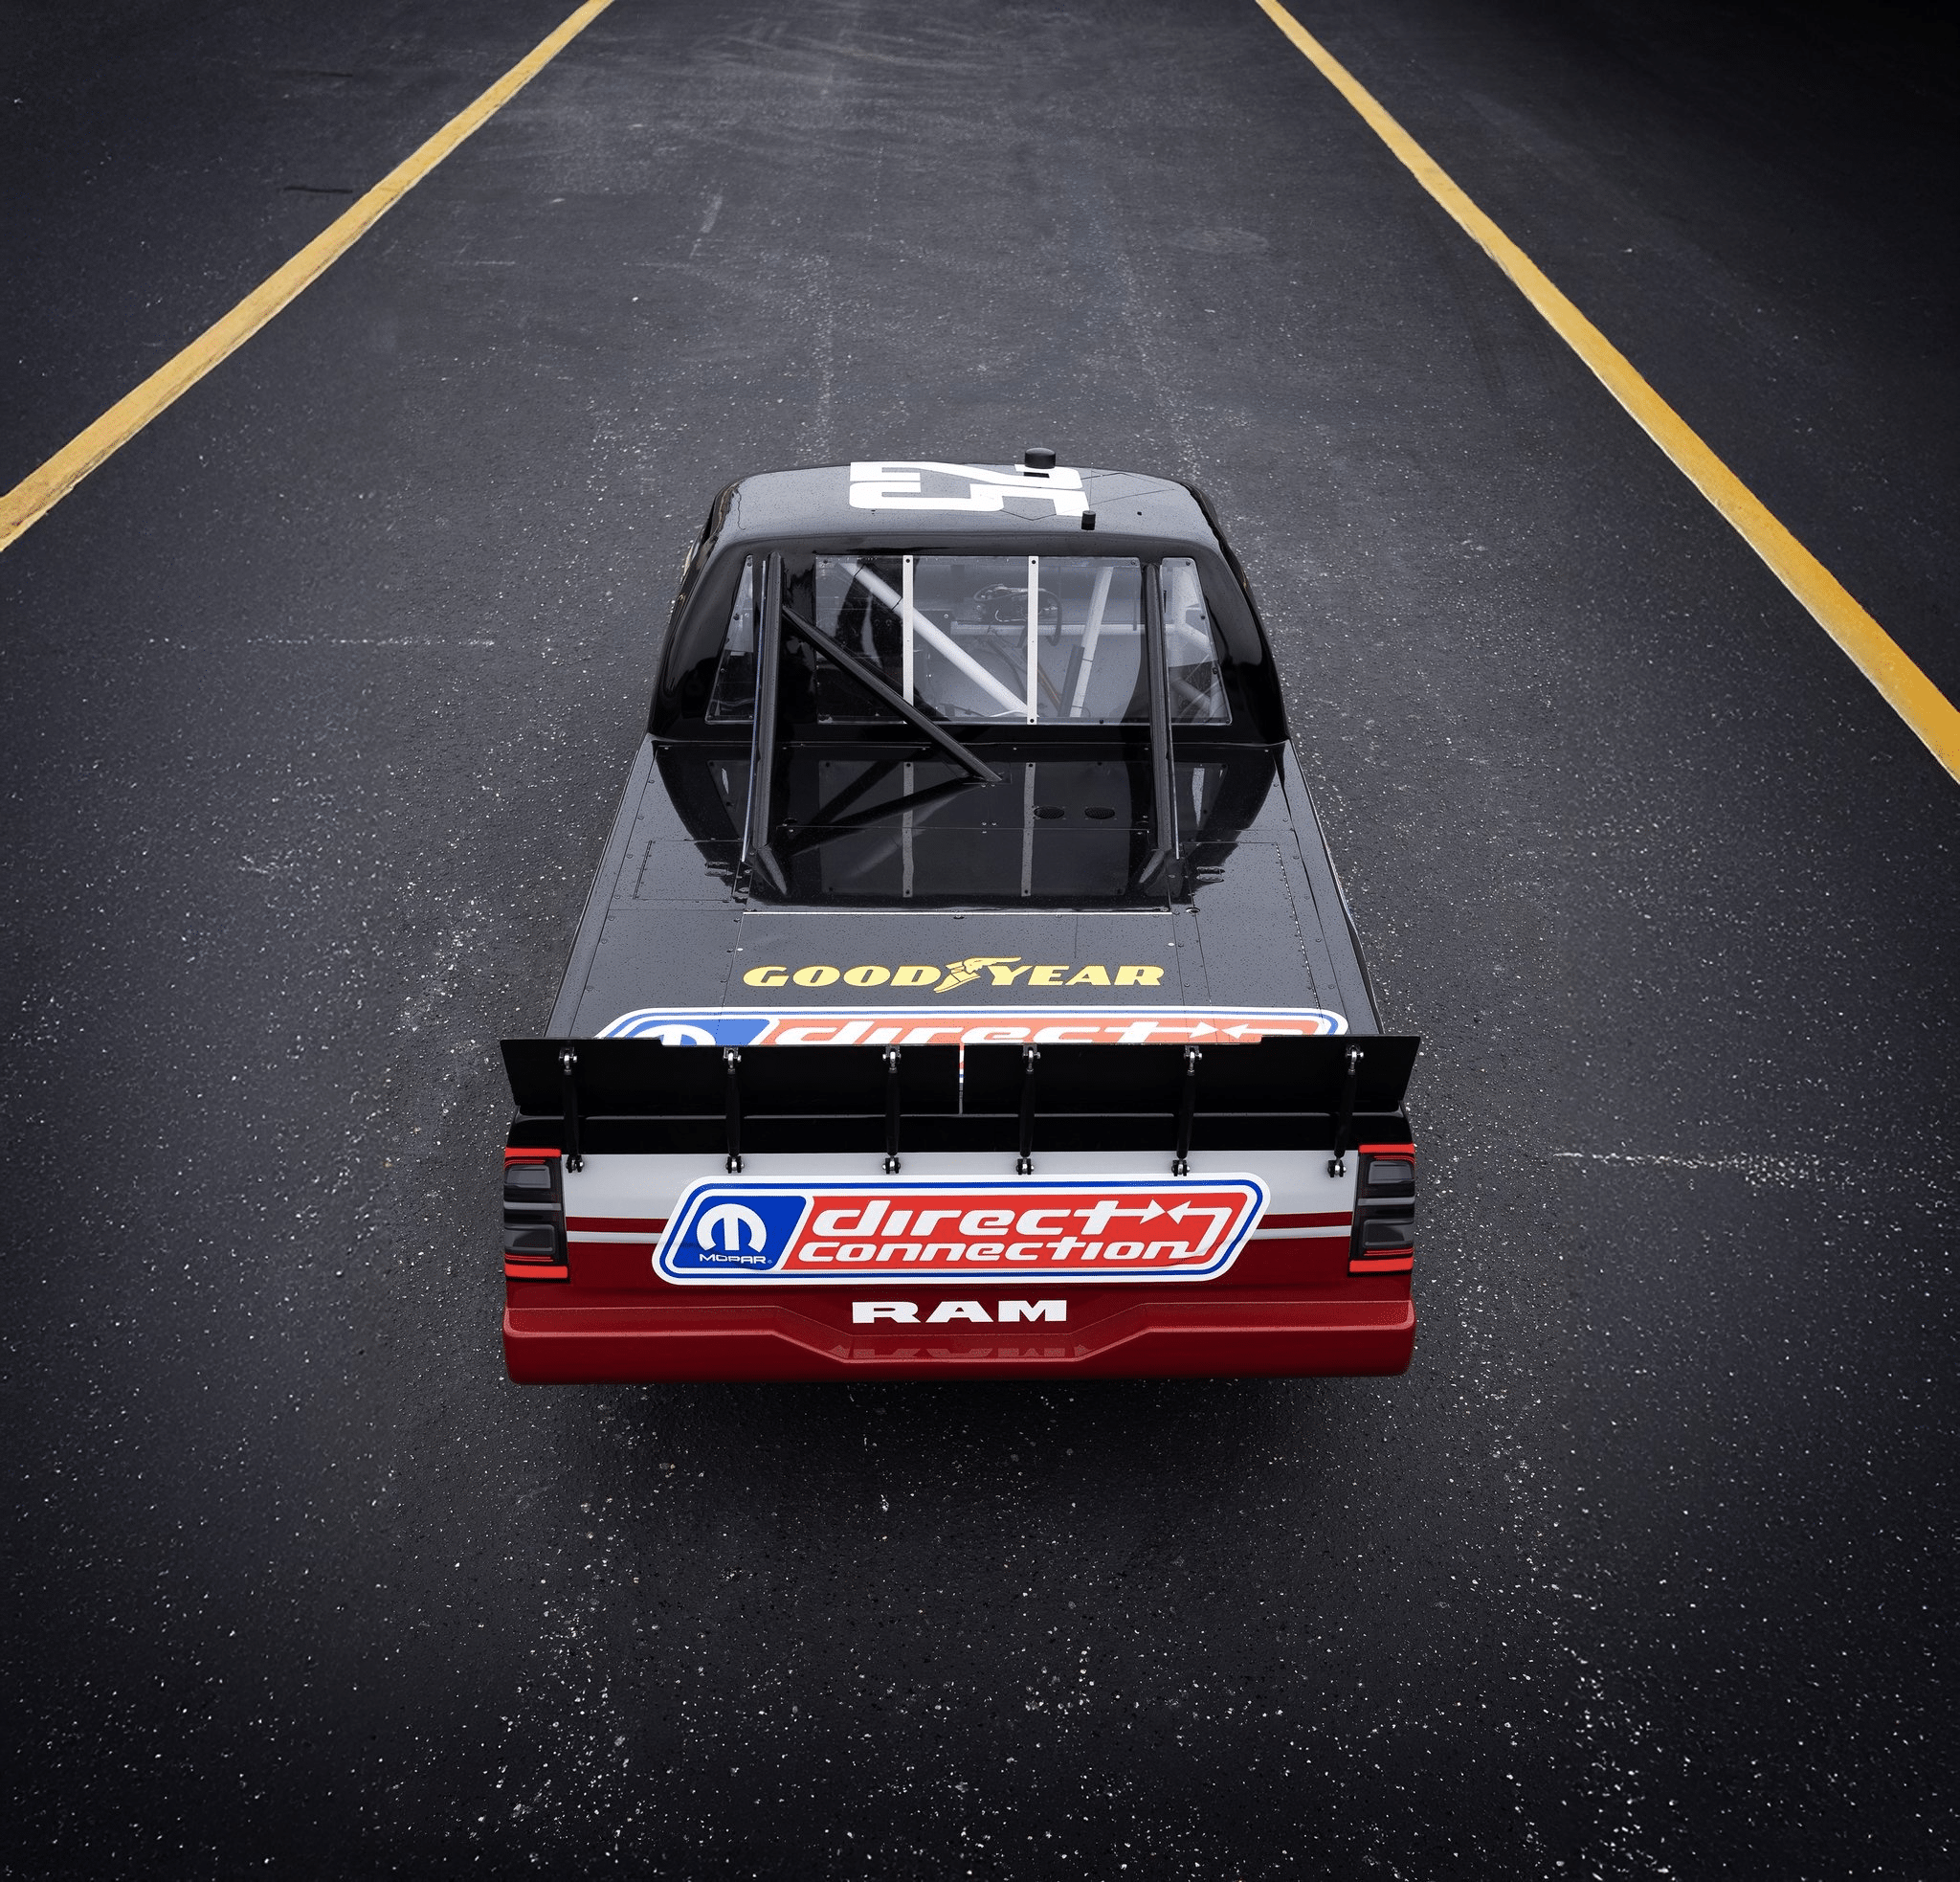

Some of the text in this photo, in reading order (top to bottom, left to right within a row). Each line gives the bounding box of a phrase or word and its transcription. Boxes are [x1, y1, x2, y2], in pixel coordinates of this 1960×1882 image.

[774, 1019, 1161, 1045] direct
[812, 1199, 1125, 1237] direct
[699, 1253, 767, 1265] MOPAR
[798, 1236, 1198, 1263] connection
[852, 1299, 1067, 1324] RAM
